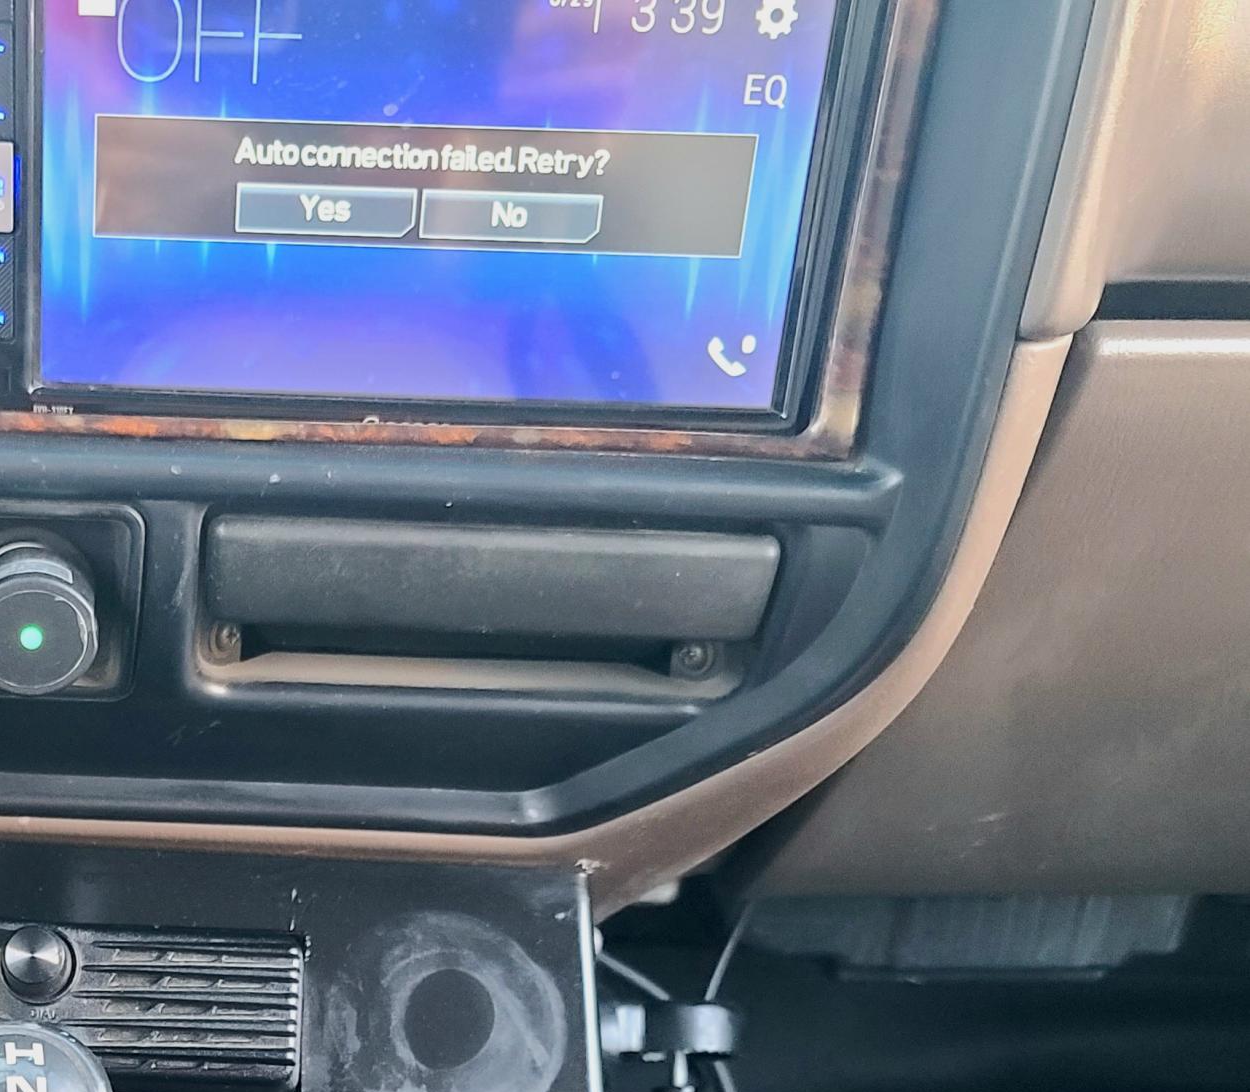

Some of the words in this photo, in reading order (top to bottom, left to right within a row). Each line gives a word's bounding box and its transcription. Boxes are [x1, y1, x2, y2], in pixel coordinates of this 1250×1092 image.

[743, 74, 788, 109] EQ
[235, 137, 300, 166] Auto
[301, 143, 442, 171] connection
[518, 147, 611, 179] Retry?
[299, 194, 352, 223] Yes
[490, 201, 529, 228] No
[4, 1042, 46, 1067] H
